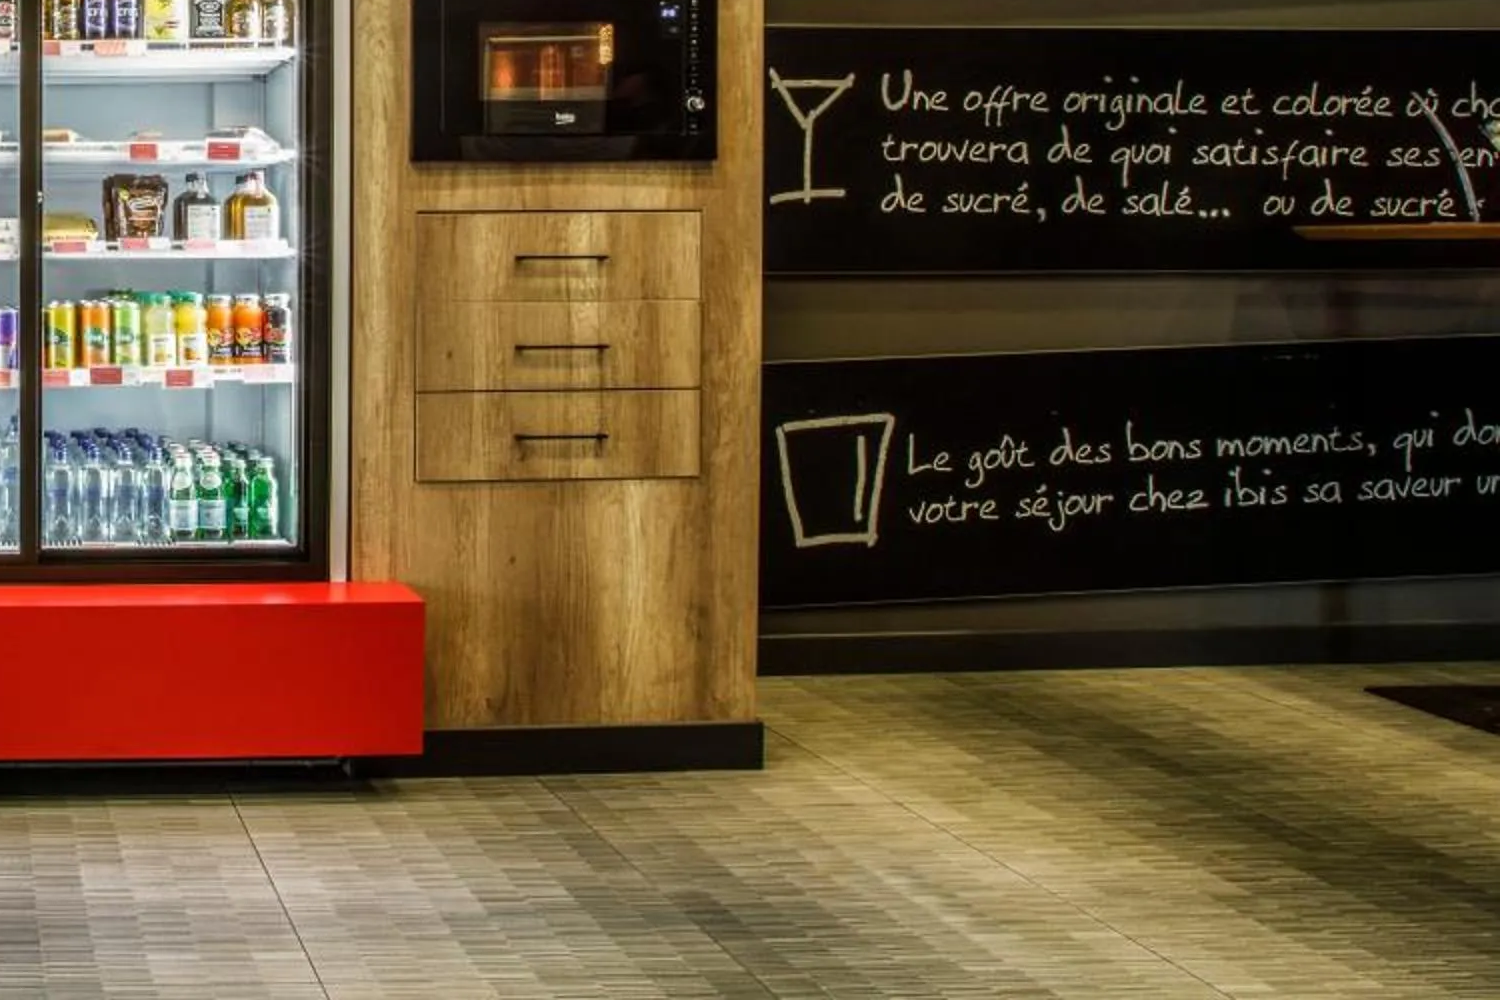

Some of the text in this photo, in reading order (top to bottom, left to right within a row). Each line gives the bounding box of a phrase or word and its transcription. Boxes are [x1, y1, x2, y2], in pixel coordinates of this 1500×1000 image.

[881, 70, 948, 111] Une
[964, 86, 1049, 127] offre
[1063, 75, 1206, 130] originale
[1221, 88, 1260, 115] et
[1273, 82, 1393, 116] colorée
[1406, 87, 1438, 117] où
[882, 124, 1500, 186] trouvera de quoi satisfaire ses en
[881, 174, 926, 212] de
[943, 189, 1046, 221] sucré,
[1061, 176, 1106, 214] de
[1263, 196, 1295, 216] ou
[1311, 178, 1354, 216] de
[1370, 188, 1456, 217] sucré
[908, 433, 952, 475] Le
[965, 434, 1035, 488] goût
[1050, 428, 1111, 465] des
[1126, 420, 1201, 461] bons
[1217, 427, 1376, 456] moments,
[1393, 411, 1438, 472] qui
[909, 496, 999, 523] votre
[1015, 484, 1114, 531] séjour
[1129, 475, 1209, 512] chez
[1225, 466, 1287, 507] ibis
[1303, 482, 1342, 503] sa
[1358, 476, 1461, 500] saveur
